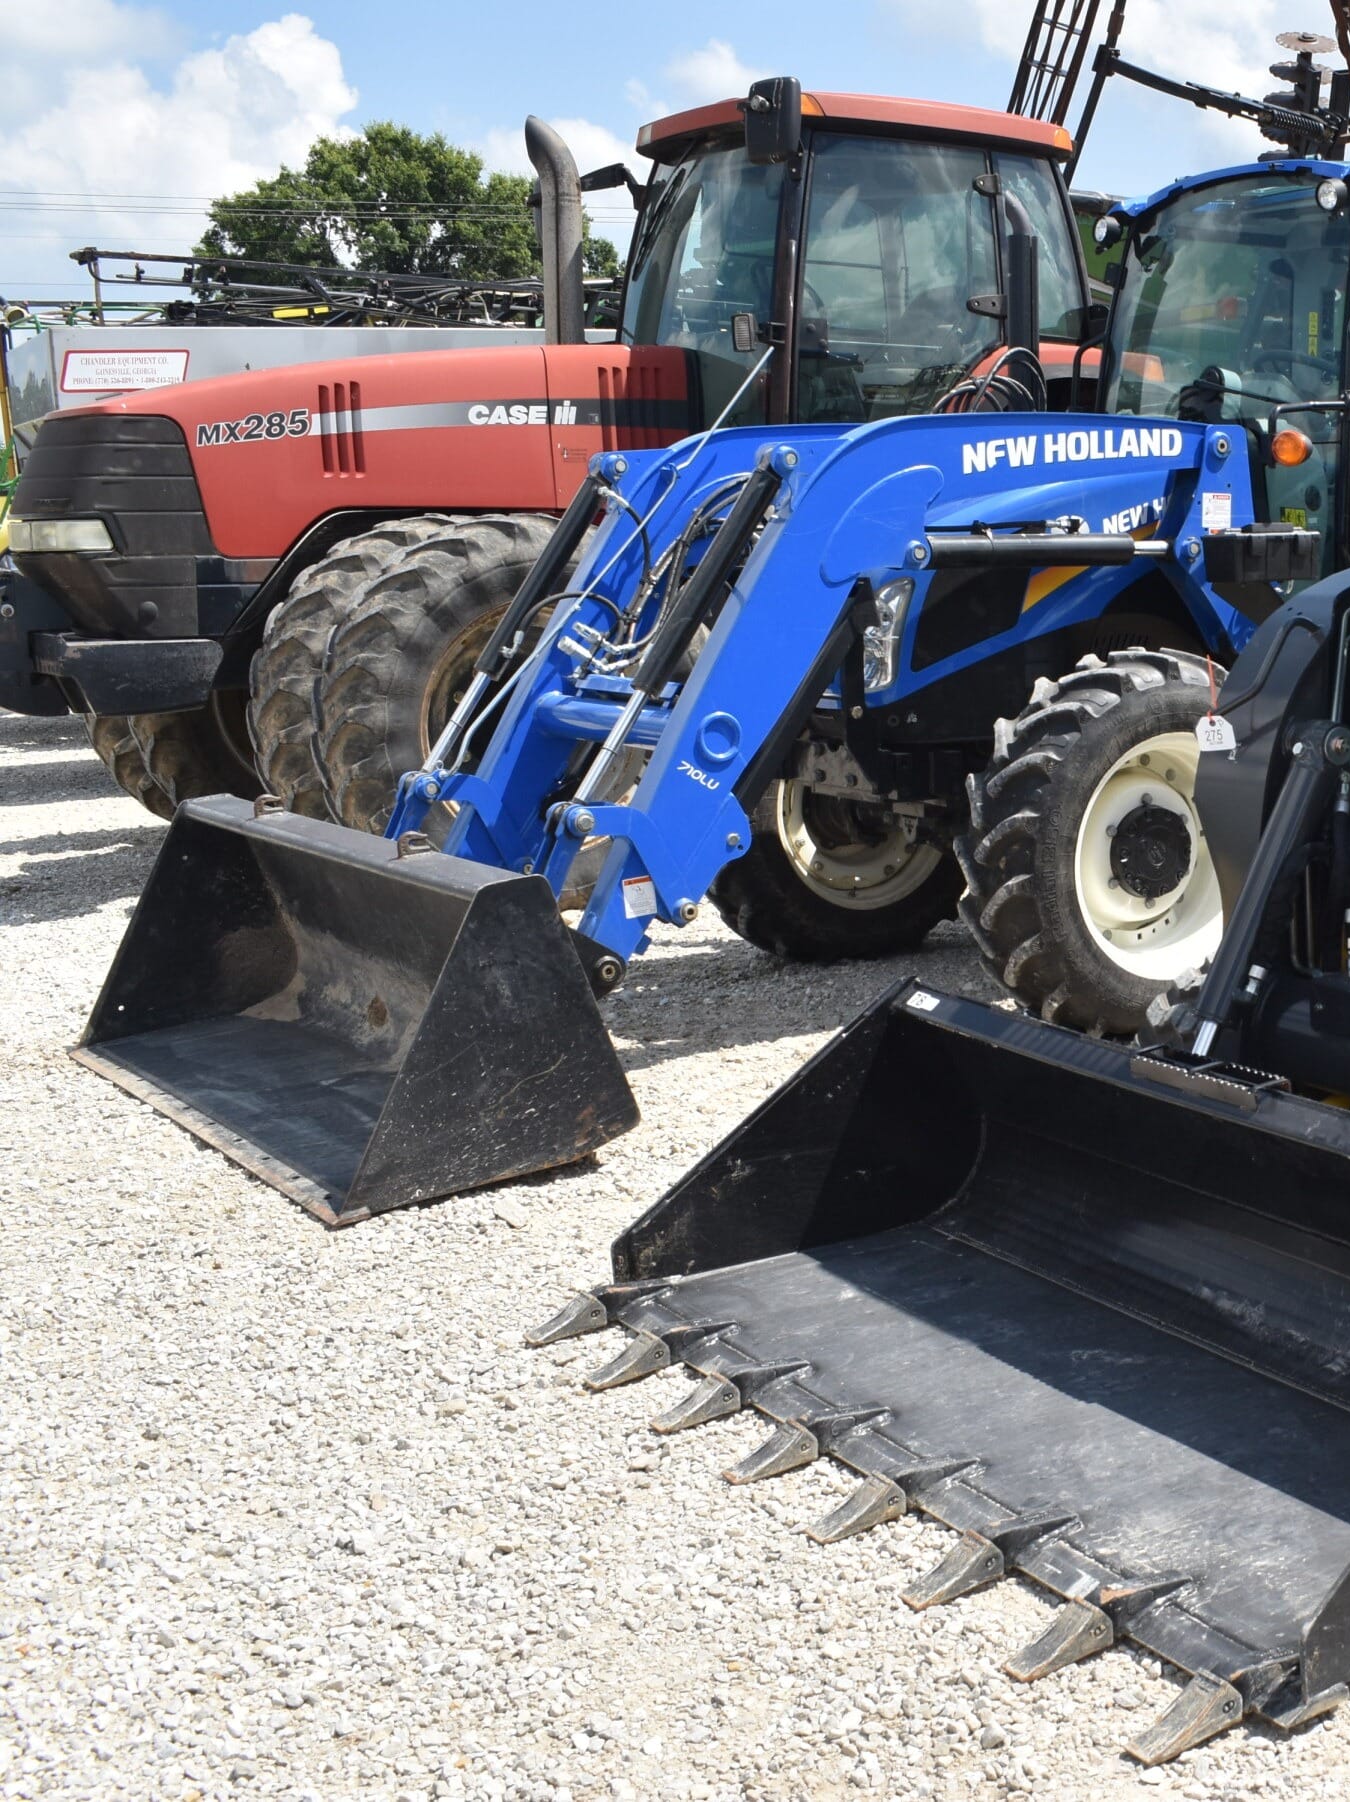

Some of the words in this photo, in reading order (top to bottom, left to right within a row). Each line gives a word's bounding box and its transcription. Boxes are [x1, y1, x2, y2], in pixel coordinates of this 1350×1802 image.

[80, 356, 116, 366] CHANDLER
[117, 356, 156, 366] EQUIPMENT
[197, 408, 309, 447] MX285
[468, 404, 549, 425] CASE
[1044, 428, 1182, 464] HOLLAND
[1102, 501, 1149, 534] NEW
[1205, 729, 1223, 742] 275
